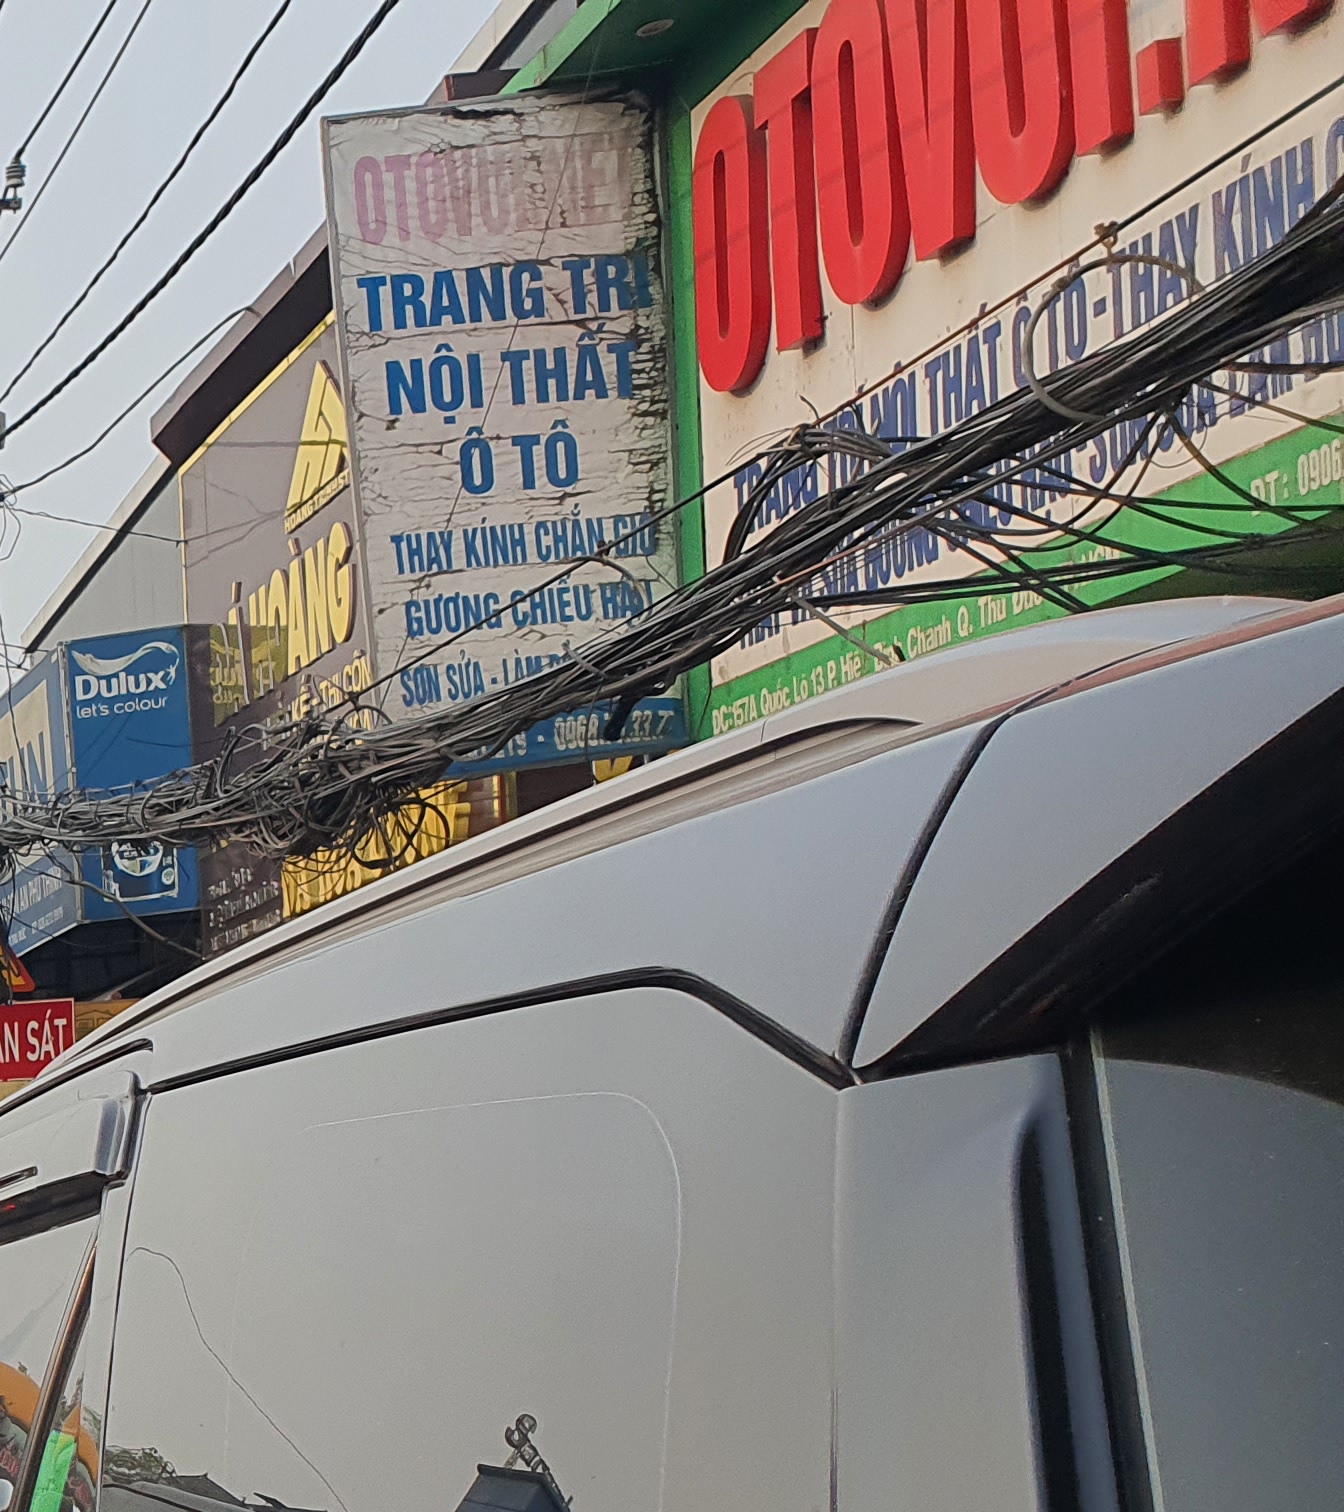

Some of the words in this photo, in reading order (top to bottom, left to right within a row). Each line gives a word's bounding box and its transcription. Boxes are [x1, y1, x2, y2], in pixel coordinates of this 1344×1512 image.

[357, 260, 545, 333] TRANG
[924, 302, 1002, 436] THẤT
[1212, 153, 1315, 283] KÍNH
[385, 342, 484, 424] NỘI
[501, 322, 638, 405] THẤT
[459, 426, 495, 495] Ô
[512, 419, 580, 490] TÔ
[390, 529, 456, 575] THAY
[462, 516, 529, 577] KÍNH
[405, 591, 502, 638] GƯƠNG
[512, 572, 593, 629] CHIẾU
[74, 671, 169, 701] Dulux
[76, 702, 110, 719] let's
[113, 696, 168, 715] colour
[400, 663, 442, 707] SƠN
[446, 649, 486, 700] SỬA
[811, 665, 825, 695] 13
[26, 1008, 68, 1062] SÁT
